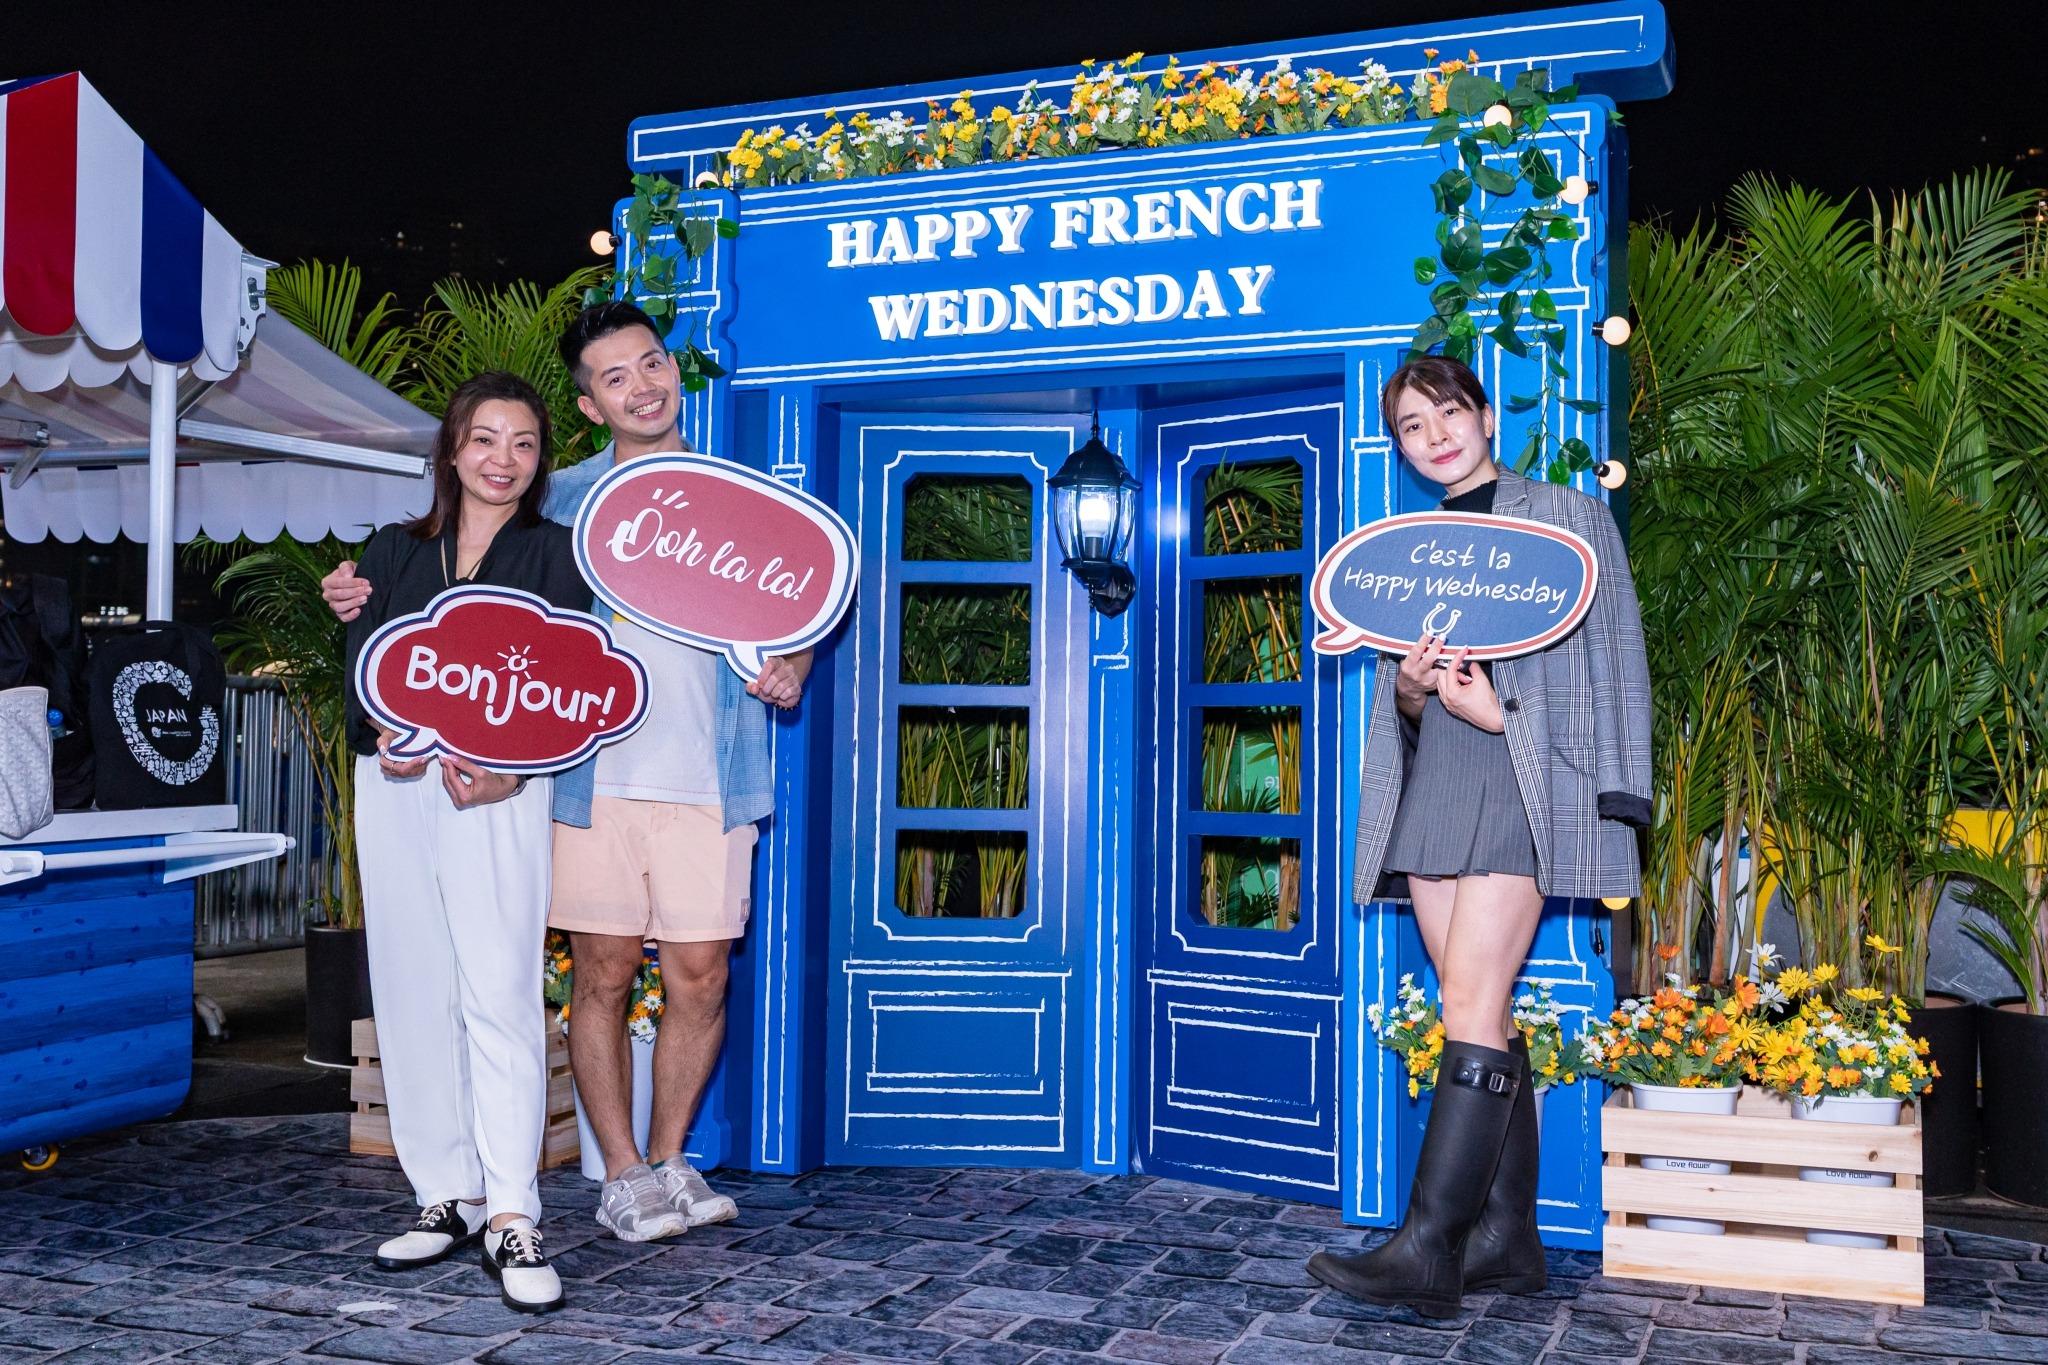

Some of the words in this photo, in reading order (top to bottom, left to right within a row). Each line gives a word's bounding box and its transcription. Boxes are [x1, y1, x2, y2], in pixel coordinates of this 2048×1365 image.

[827, 204, 1033, 268] HAPPY
[1050, 179, 1324, 250] FRENCH
[868, 265, 1276, 341] WEDNESDAY
[605, 507, 706, 562] Ooh
[709, 540, 754, 583] la
[757, 556, 814, 600] la!
[1410, 540, 1475, 567] C'est
[1488, 546, 1511, 569] la
[1344, 566, 1417, 601] Happy
[1425, 573, 1568, 614] Wednesday
[146, 708, 188, 723] JAPAN
[405, 644, 616, 727] Bonjour!
[1666, 1160, 1686, 1168] Love
[1688, 1161, 1711, 1169] flower
